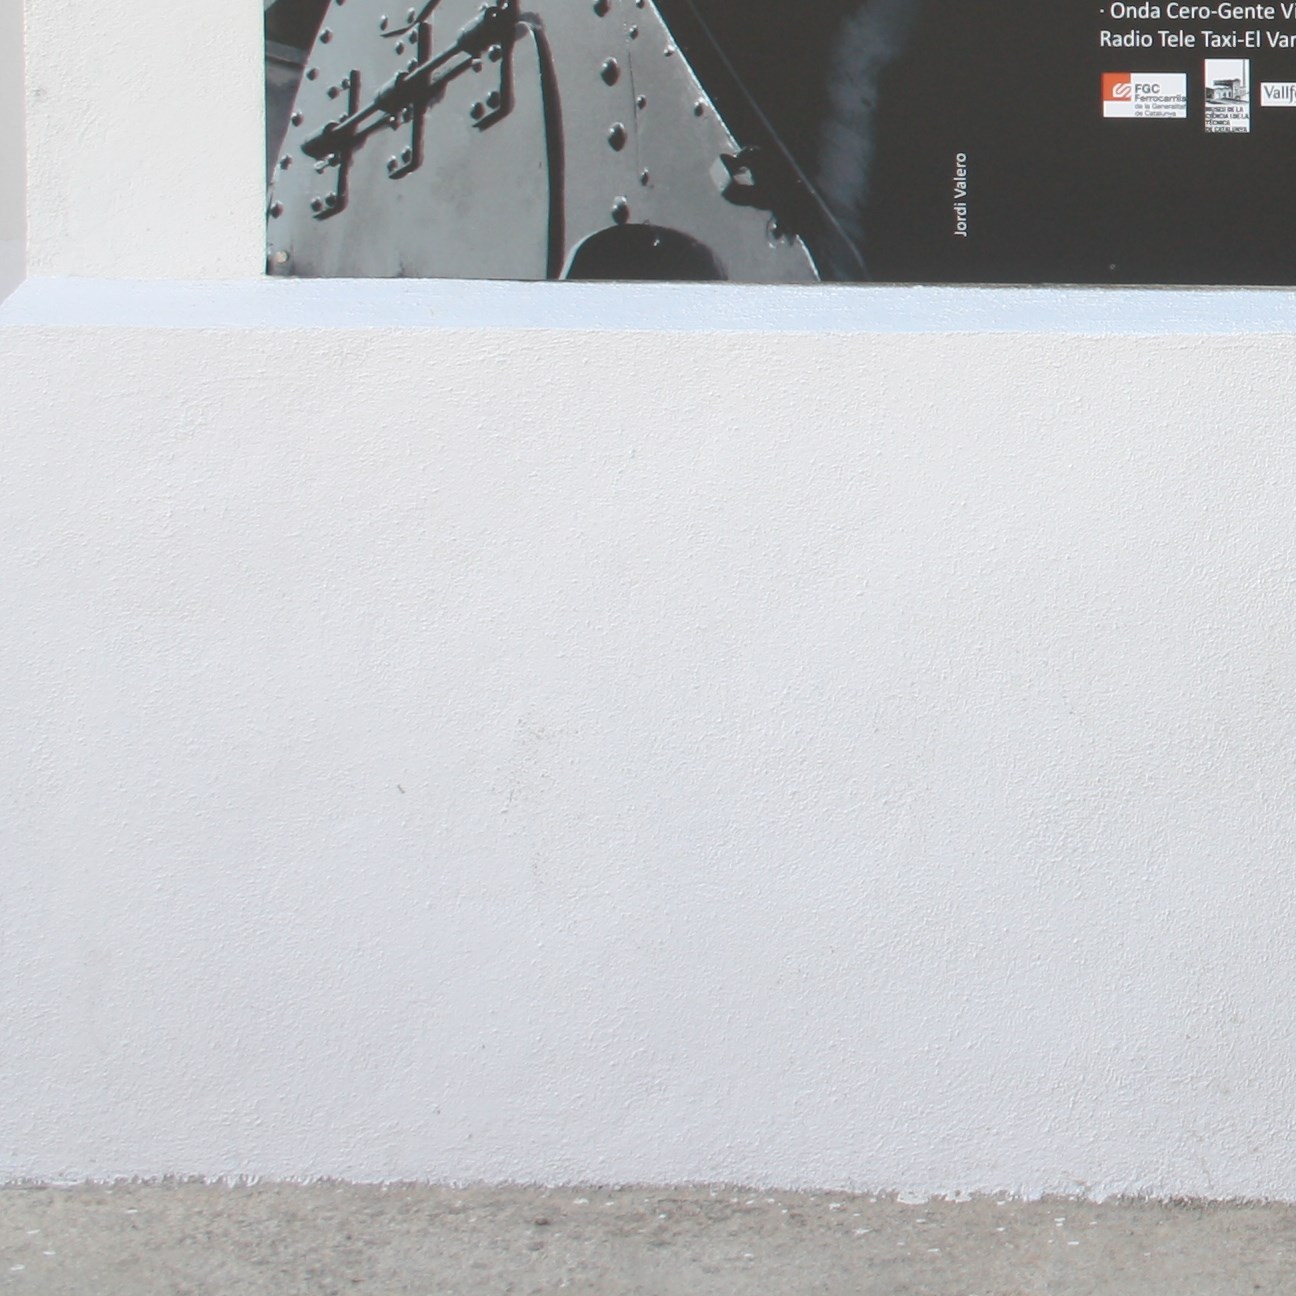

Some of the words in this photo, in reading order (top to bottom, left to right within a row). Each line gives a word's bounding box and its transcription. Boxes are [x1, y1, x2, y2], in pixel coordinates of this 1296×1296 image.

[1110, 1, 1161, 19] Onda
[1166, 1, 1275, 20] Cero-Gente
[1100, 29, 1153, 48] Radio
[1157, 29, 1196, 48] Tele
[1200, 29, 1261, 48] Taxi-El
[1135, 83, 1161, 94] FGC
[953, 152, 967, 199] Valero
[953, 202, 967, 237] Jordi
